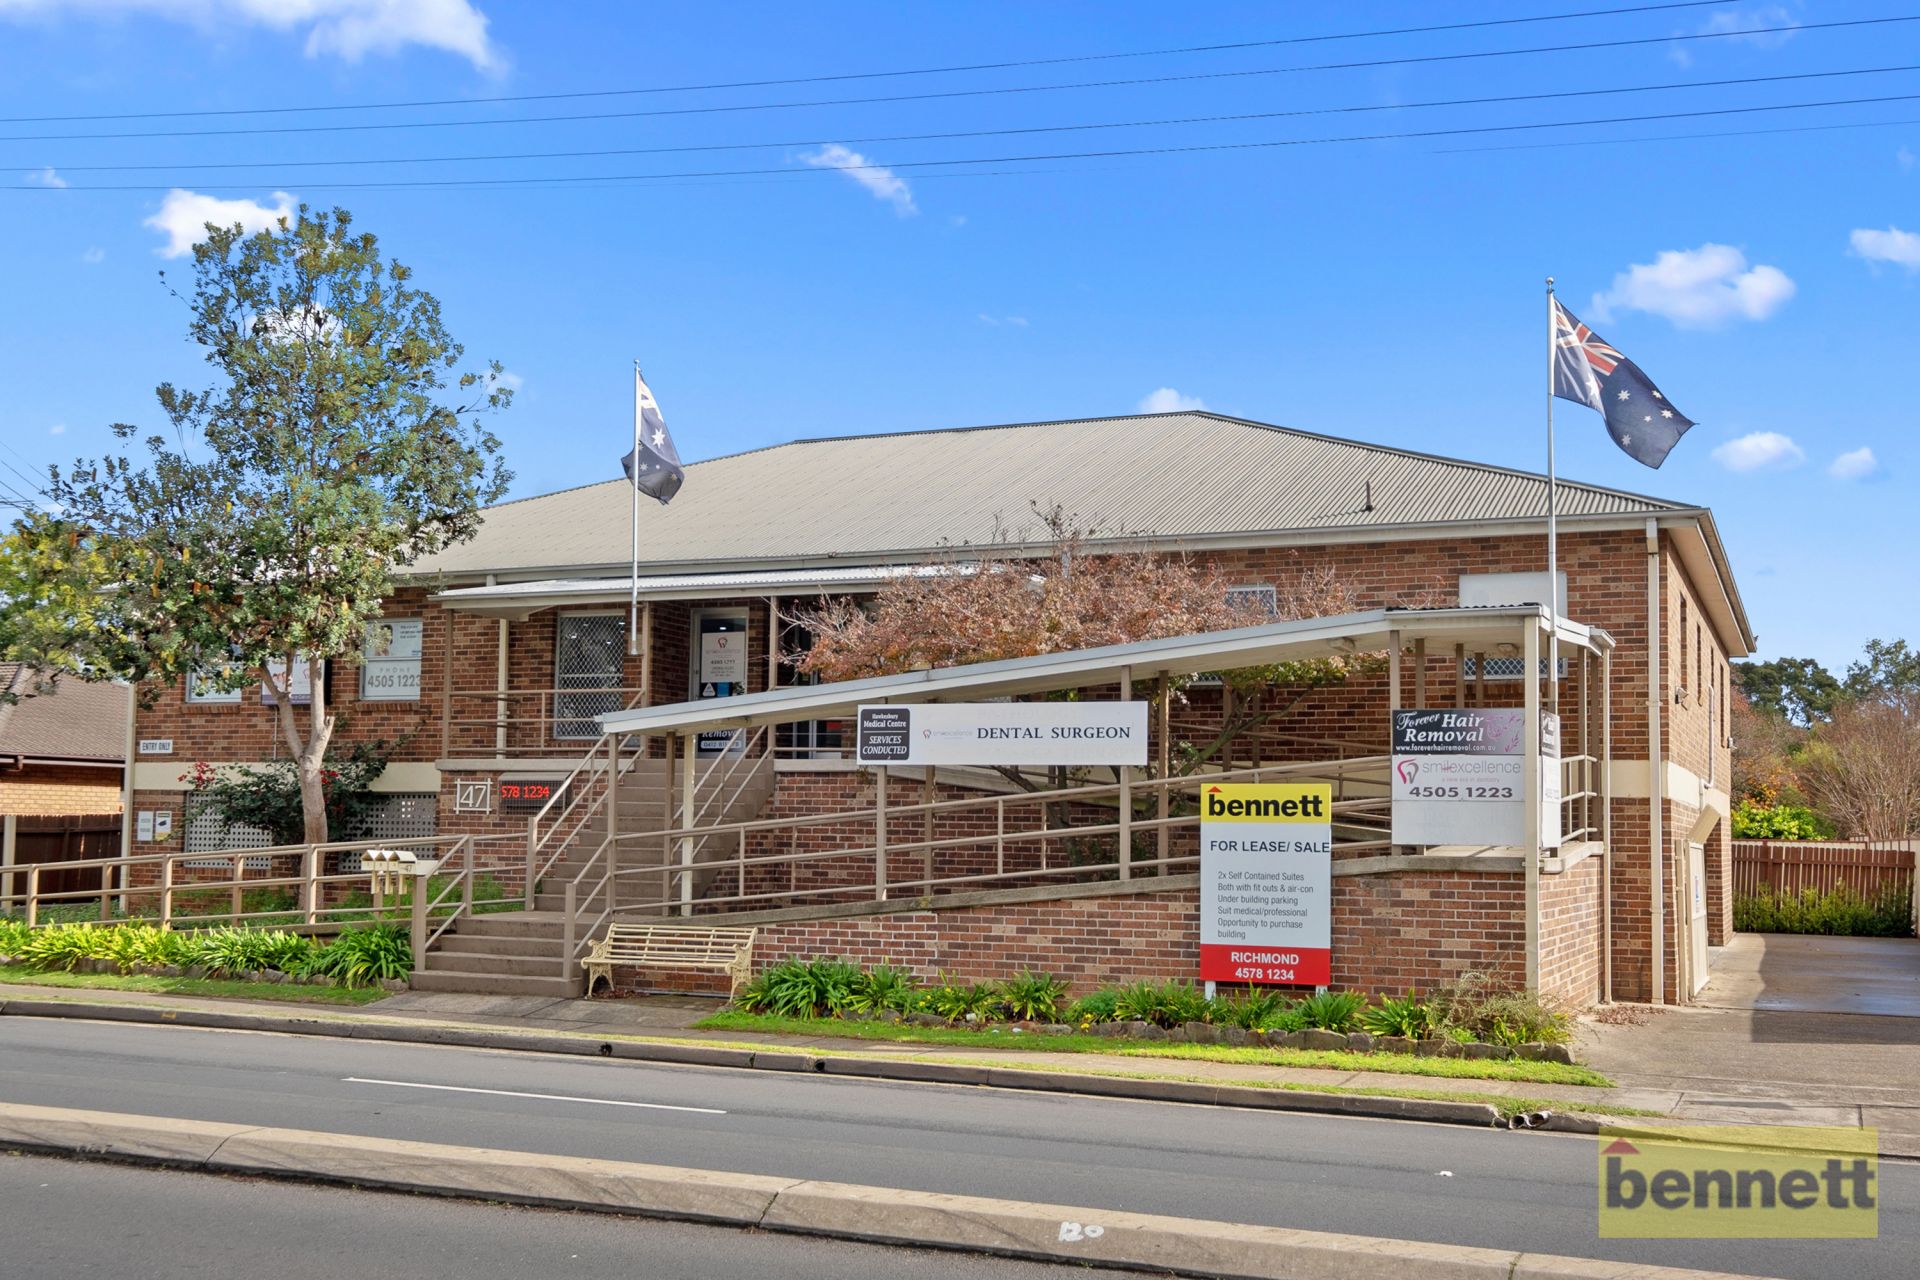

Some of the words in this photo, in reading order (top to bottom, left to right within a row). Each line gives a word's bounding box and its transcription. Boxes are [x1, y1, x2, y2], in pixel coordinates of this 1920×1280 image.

[368, 674, 394, 688] 4505
[397, 674, 421, 687] 1223
[1396, 711, 1440, 730] Forever
[1442, 714, 1484, 728] Hair
[977, 727, 1043, 739] DENTAL
[1051, 726, 1130, 738] SURGEON
[1404, 728, 1484, 742] Removal
[869, 736, 902, 744] SERVICES
[142, 742, 157, 751] ENTRY
[158, 742, 171, 751] ONLY
[862, 746, 907, 754] CONDUCTED
[1396, 744, 1496, 752] www.foreverhairremoval.com.au
[1422, 760, 1520, 774] smilexcellence
[460, 785, 487, 808] 47
[524, 786, 550, 798] 1234
[1410, 786, 1459, 798] 4505
[1466, 787, 1513, 798] 1223
[1208, 794, 1322, 817] bennett
[1210, 840, 1238, 852] FOR
[1242, 841, 1290, 853] LEASE/
[1294, 842, 1330, 853] SALE
[1218, 871, 1226, 880] 2x
[1228, 871, 1242, 880] Self
[1244, 872, 1280, 880] Contained
[1282, 872, 1304, 881] Suites
[1218, 883, 1234, 891] Both
[1236, 883, 1251, 891] with
[1280, 884, 1286, 892] &
[1218, 894, 1239, 903] Under
[1241, 895, 1269, 905] building
[1271, 896, 1298, 906] parking
[1218, 906, 1232, 915] Suit
[1234, 907, 1308, 917] medical/professional
[1218, 918, 1258, 928] Opportunity
[1270, 920, 1303, 929] purchase
[1218, 930, 1246, 940] building
[1231, 952, 1300, 965] RICHMOND
[1235, 968, 1263, 979] 4578
[1267, 968, 1294, 980] 1234
